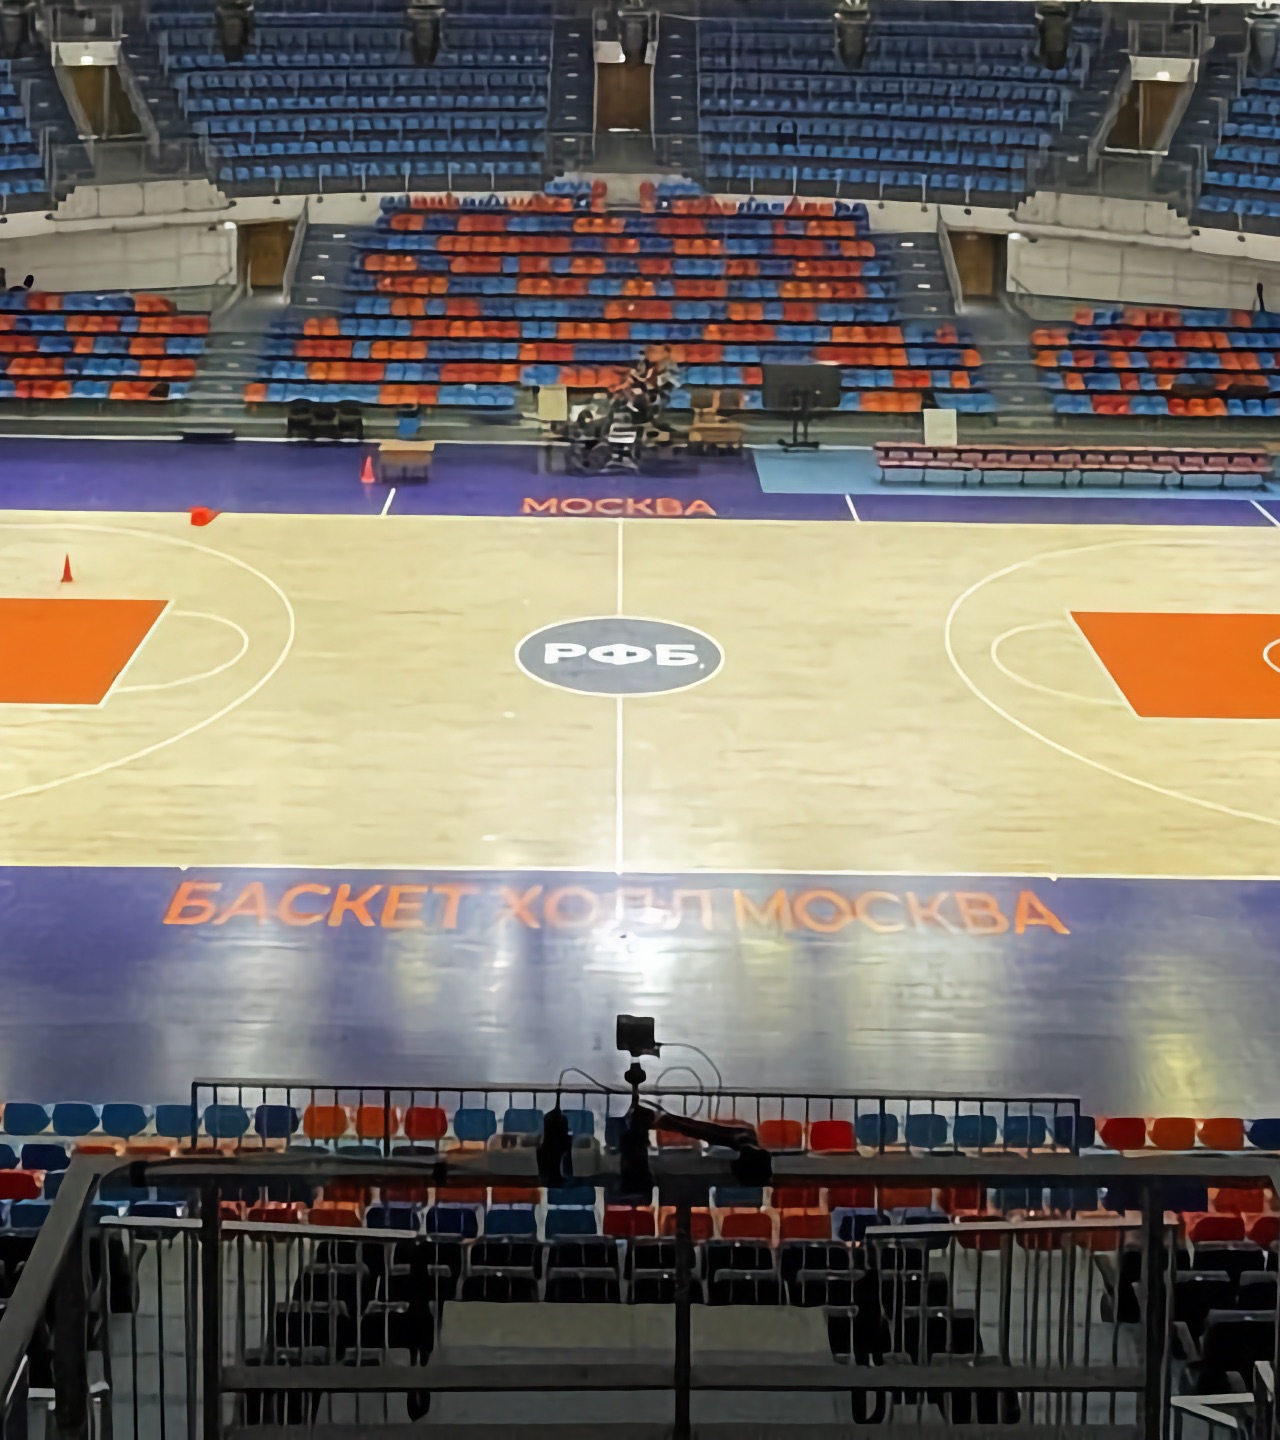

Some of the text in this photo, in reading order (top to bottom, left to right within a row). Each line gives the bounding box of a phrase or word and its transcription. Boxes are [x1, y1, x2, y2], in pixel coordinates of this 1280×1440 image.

[521, 497, 718, 517] МОСКВА
[543, 642, 699, 667] РФБ
[162, 878, 480, 930] БАСКЕТ
[733, 887, 1072, 936] МОСКВА
